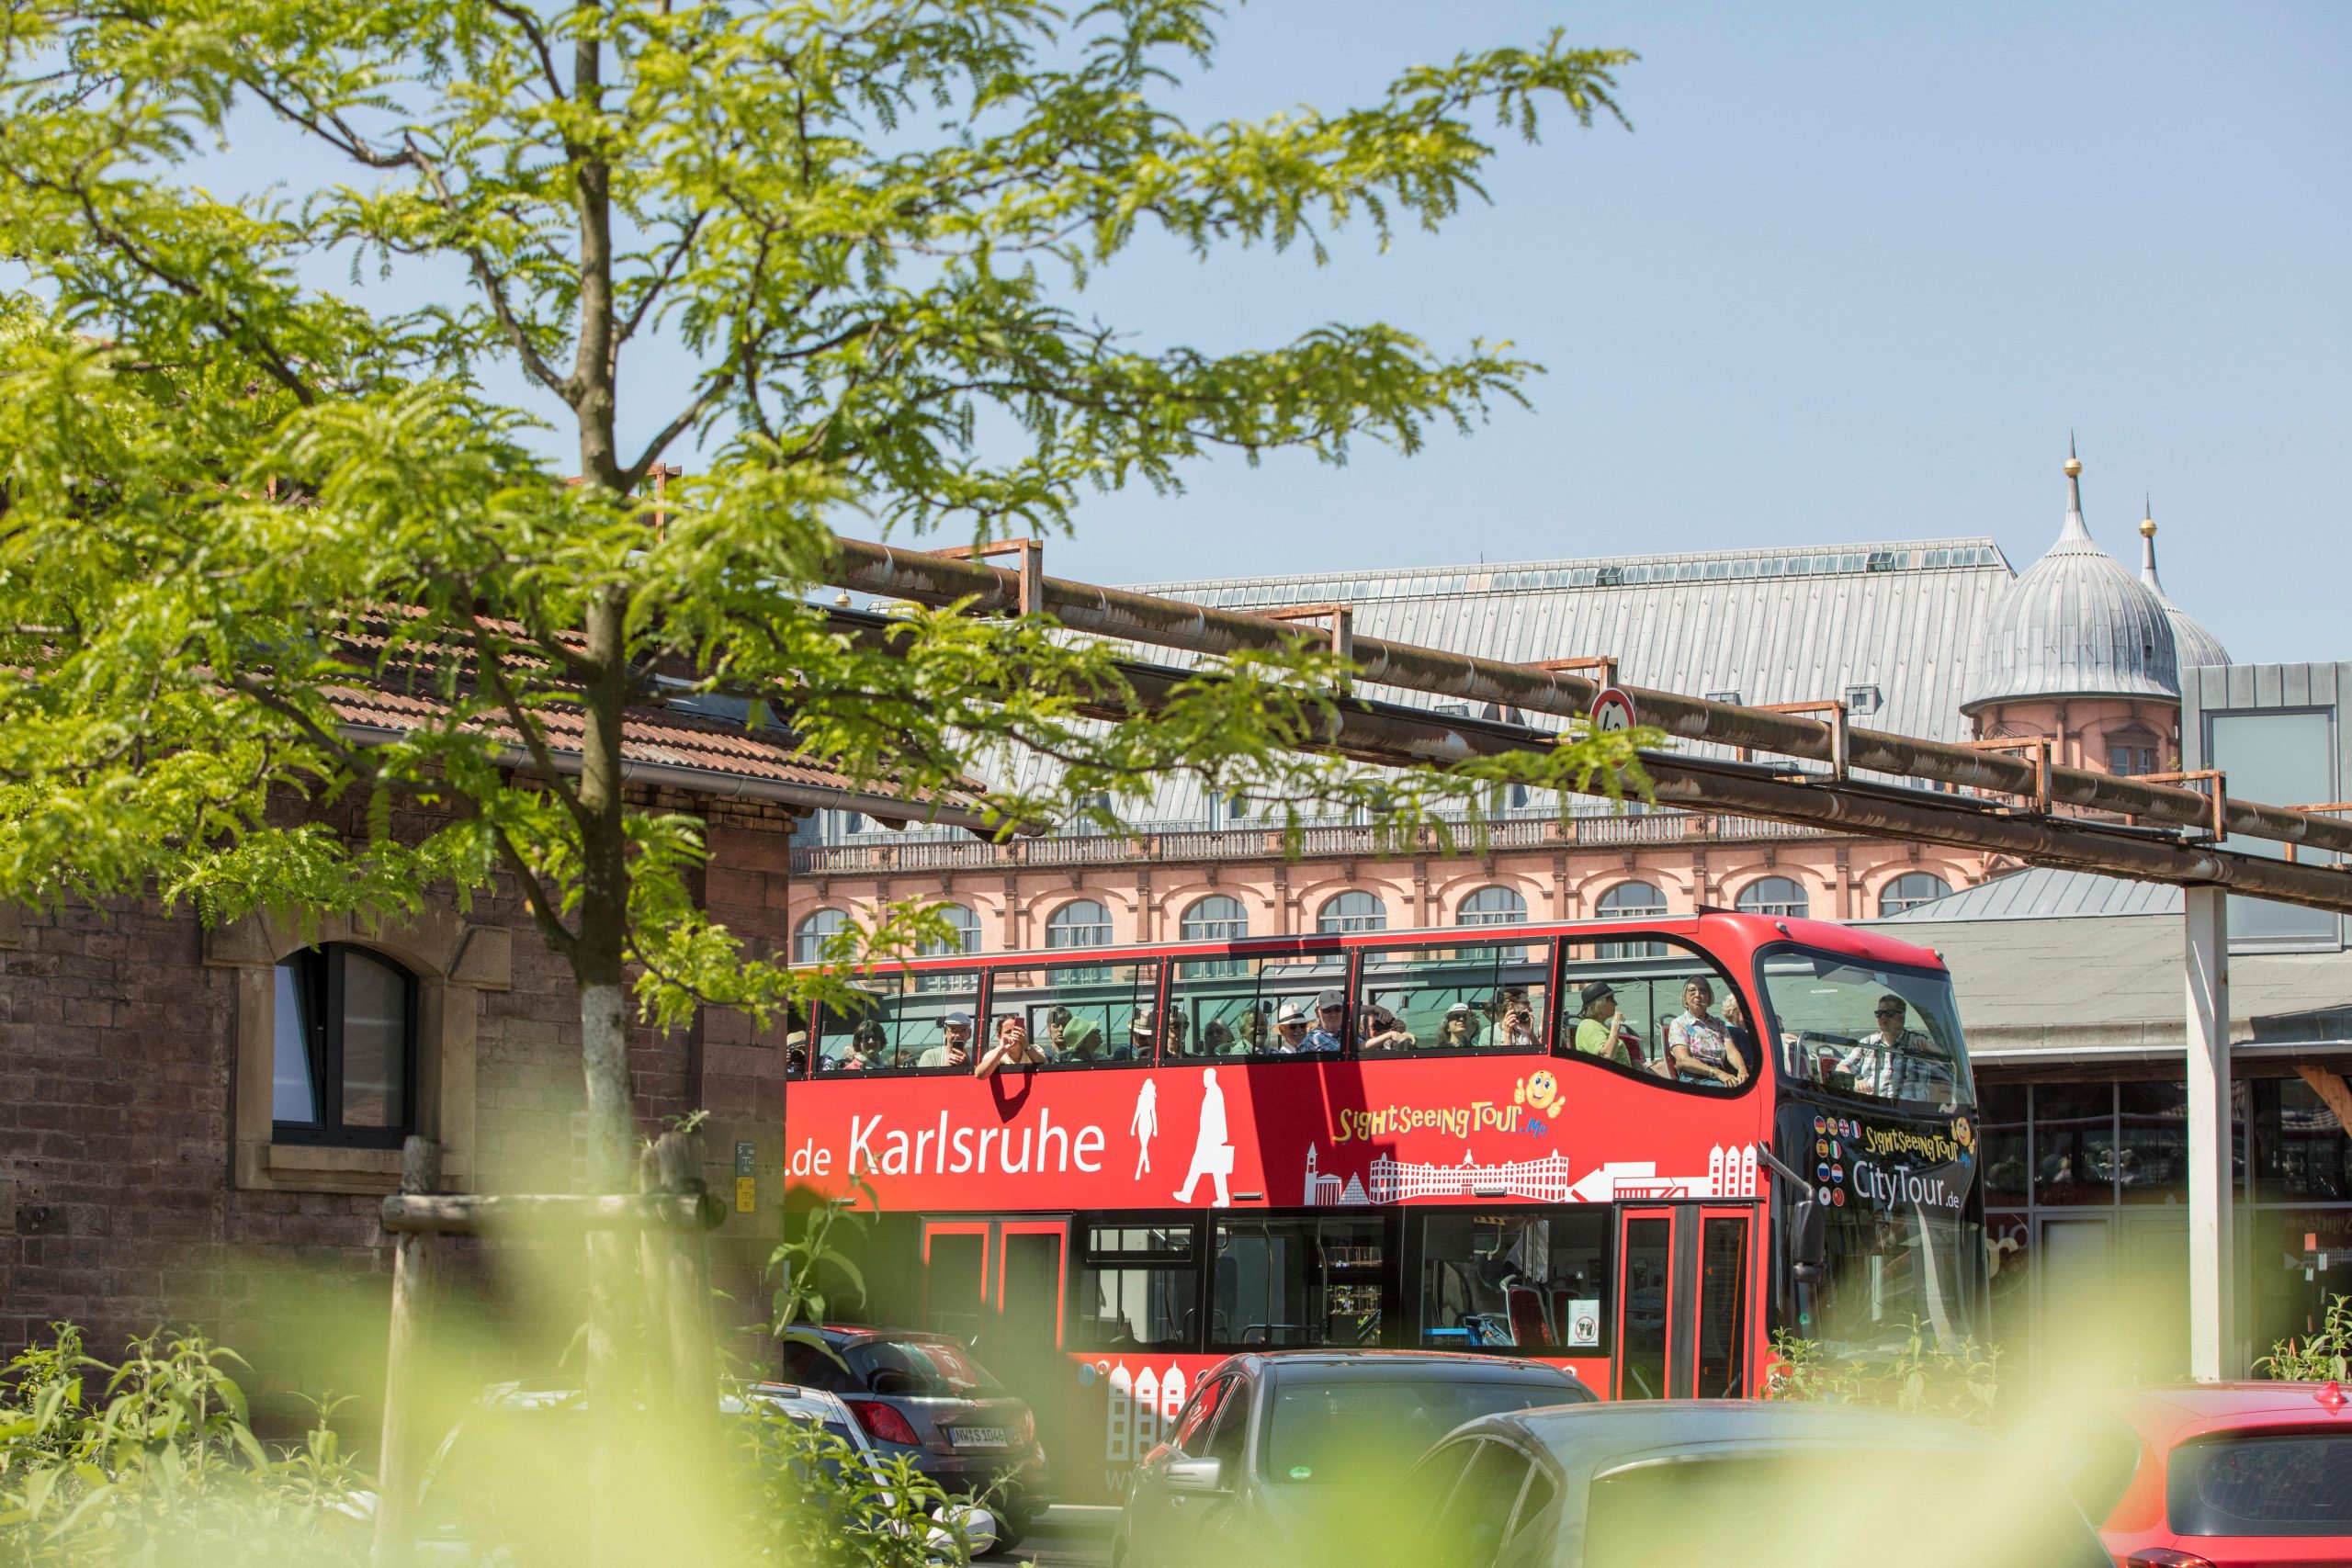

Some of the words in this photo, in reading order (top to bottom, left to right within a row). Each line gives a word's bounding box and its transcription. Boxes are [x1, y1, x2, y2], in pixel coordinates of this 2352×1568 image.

[785, 1138, 831, 1176] .de
[848, 1108, 1104, 1175] Karlsruhe
[1853, 1160, 1960, 1211] CityTour.de
[955, 1428, 968, 1442] NW
